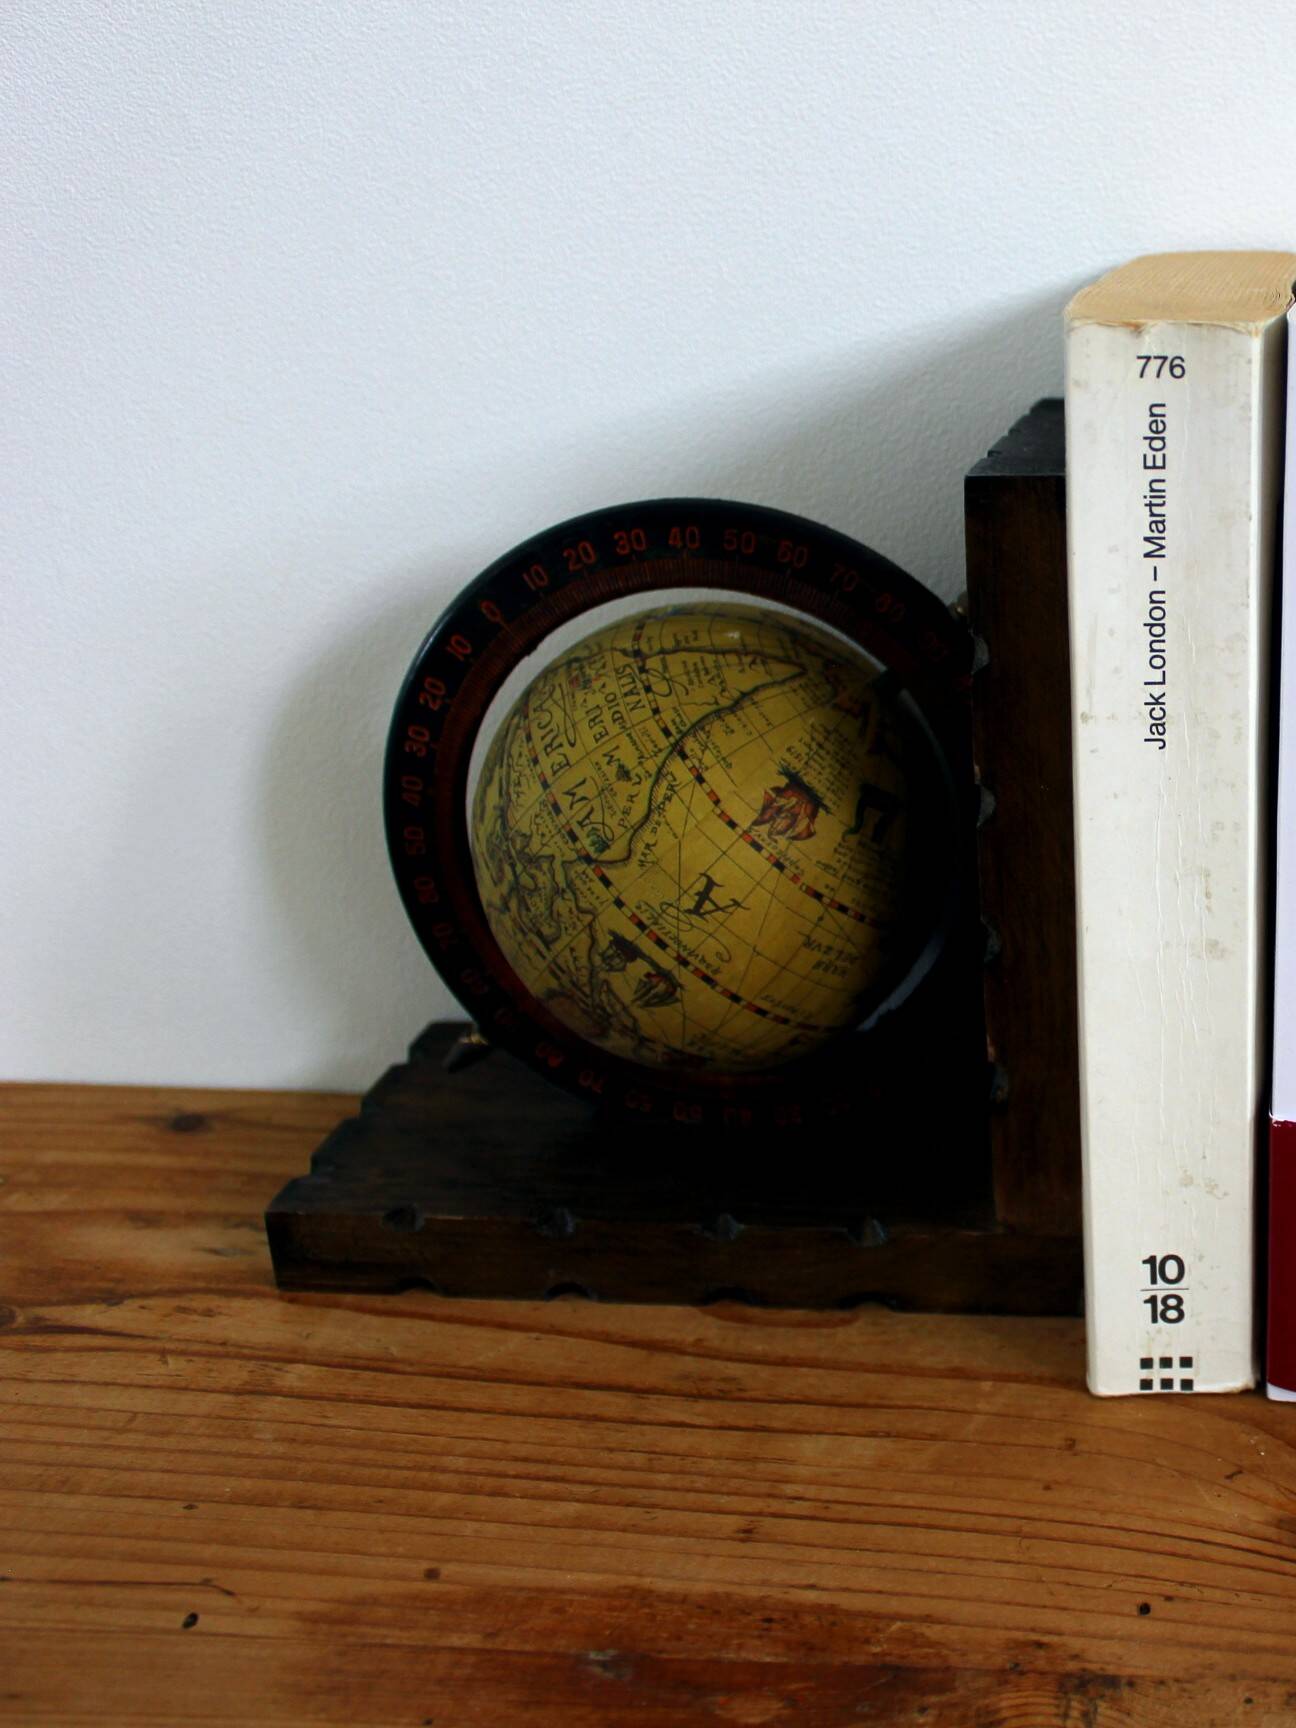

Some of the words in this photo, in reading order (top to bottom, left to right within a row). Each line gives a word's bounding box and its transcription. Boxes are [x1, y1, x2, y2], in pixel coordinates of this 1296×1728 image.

[1135, 354, 1187, 380] 776
[1143, 402, 1168, 471] Eden
[1143, 475, 1167, 560] Martin
[561, 537, 597, 572] 20
[611, 526, 649, 557] 30
[668, 525, 701, 550] 40
[722, 528, 758, 556] 50
[776, 538, 810, 570] 60
[522, 561, 550, 590] 10
[445, 630, 474, 661] 10
[1143, 589, 1168, 687] London
[417, 674, 449, 712] 20
[1143, 692, 1167, 751] Jack
[403, 723, 431, 759] 30
[400, 773, 425, 808] 40
[1140, 1253, 1187, 1287] 10
[1142, 1292, 1187, 1325] 18
